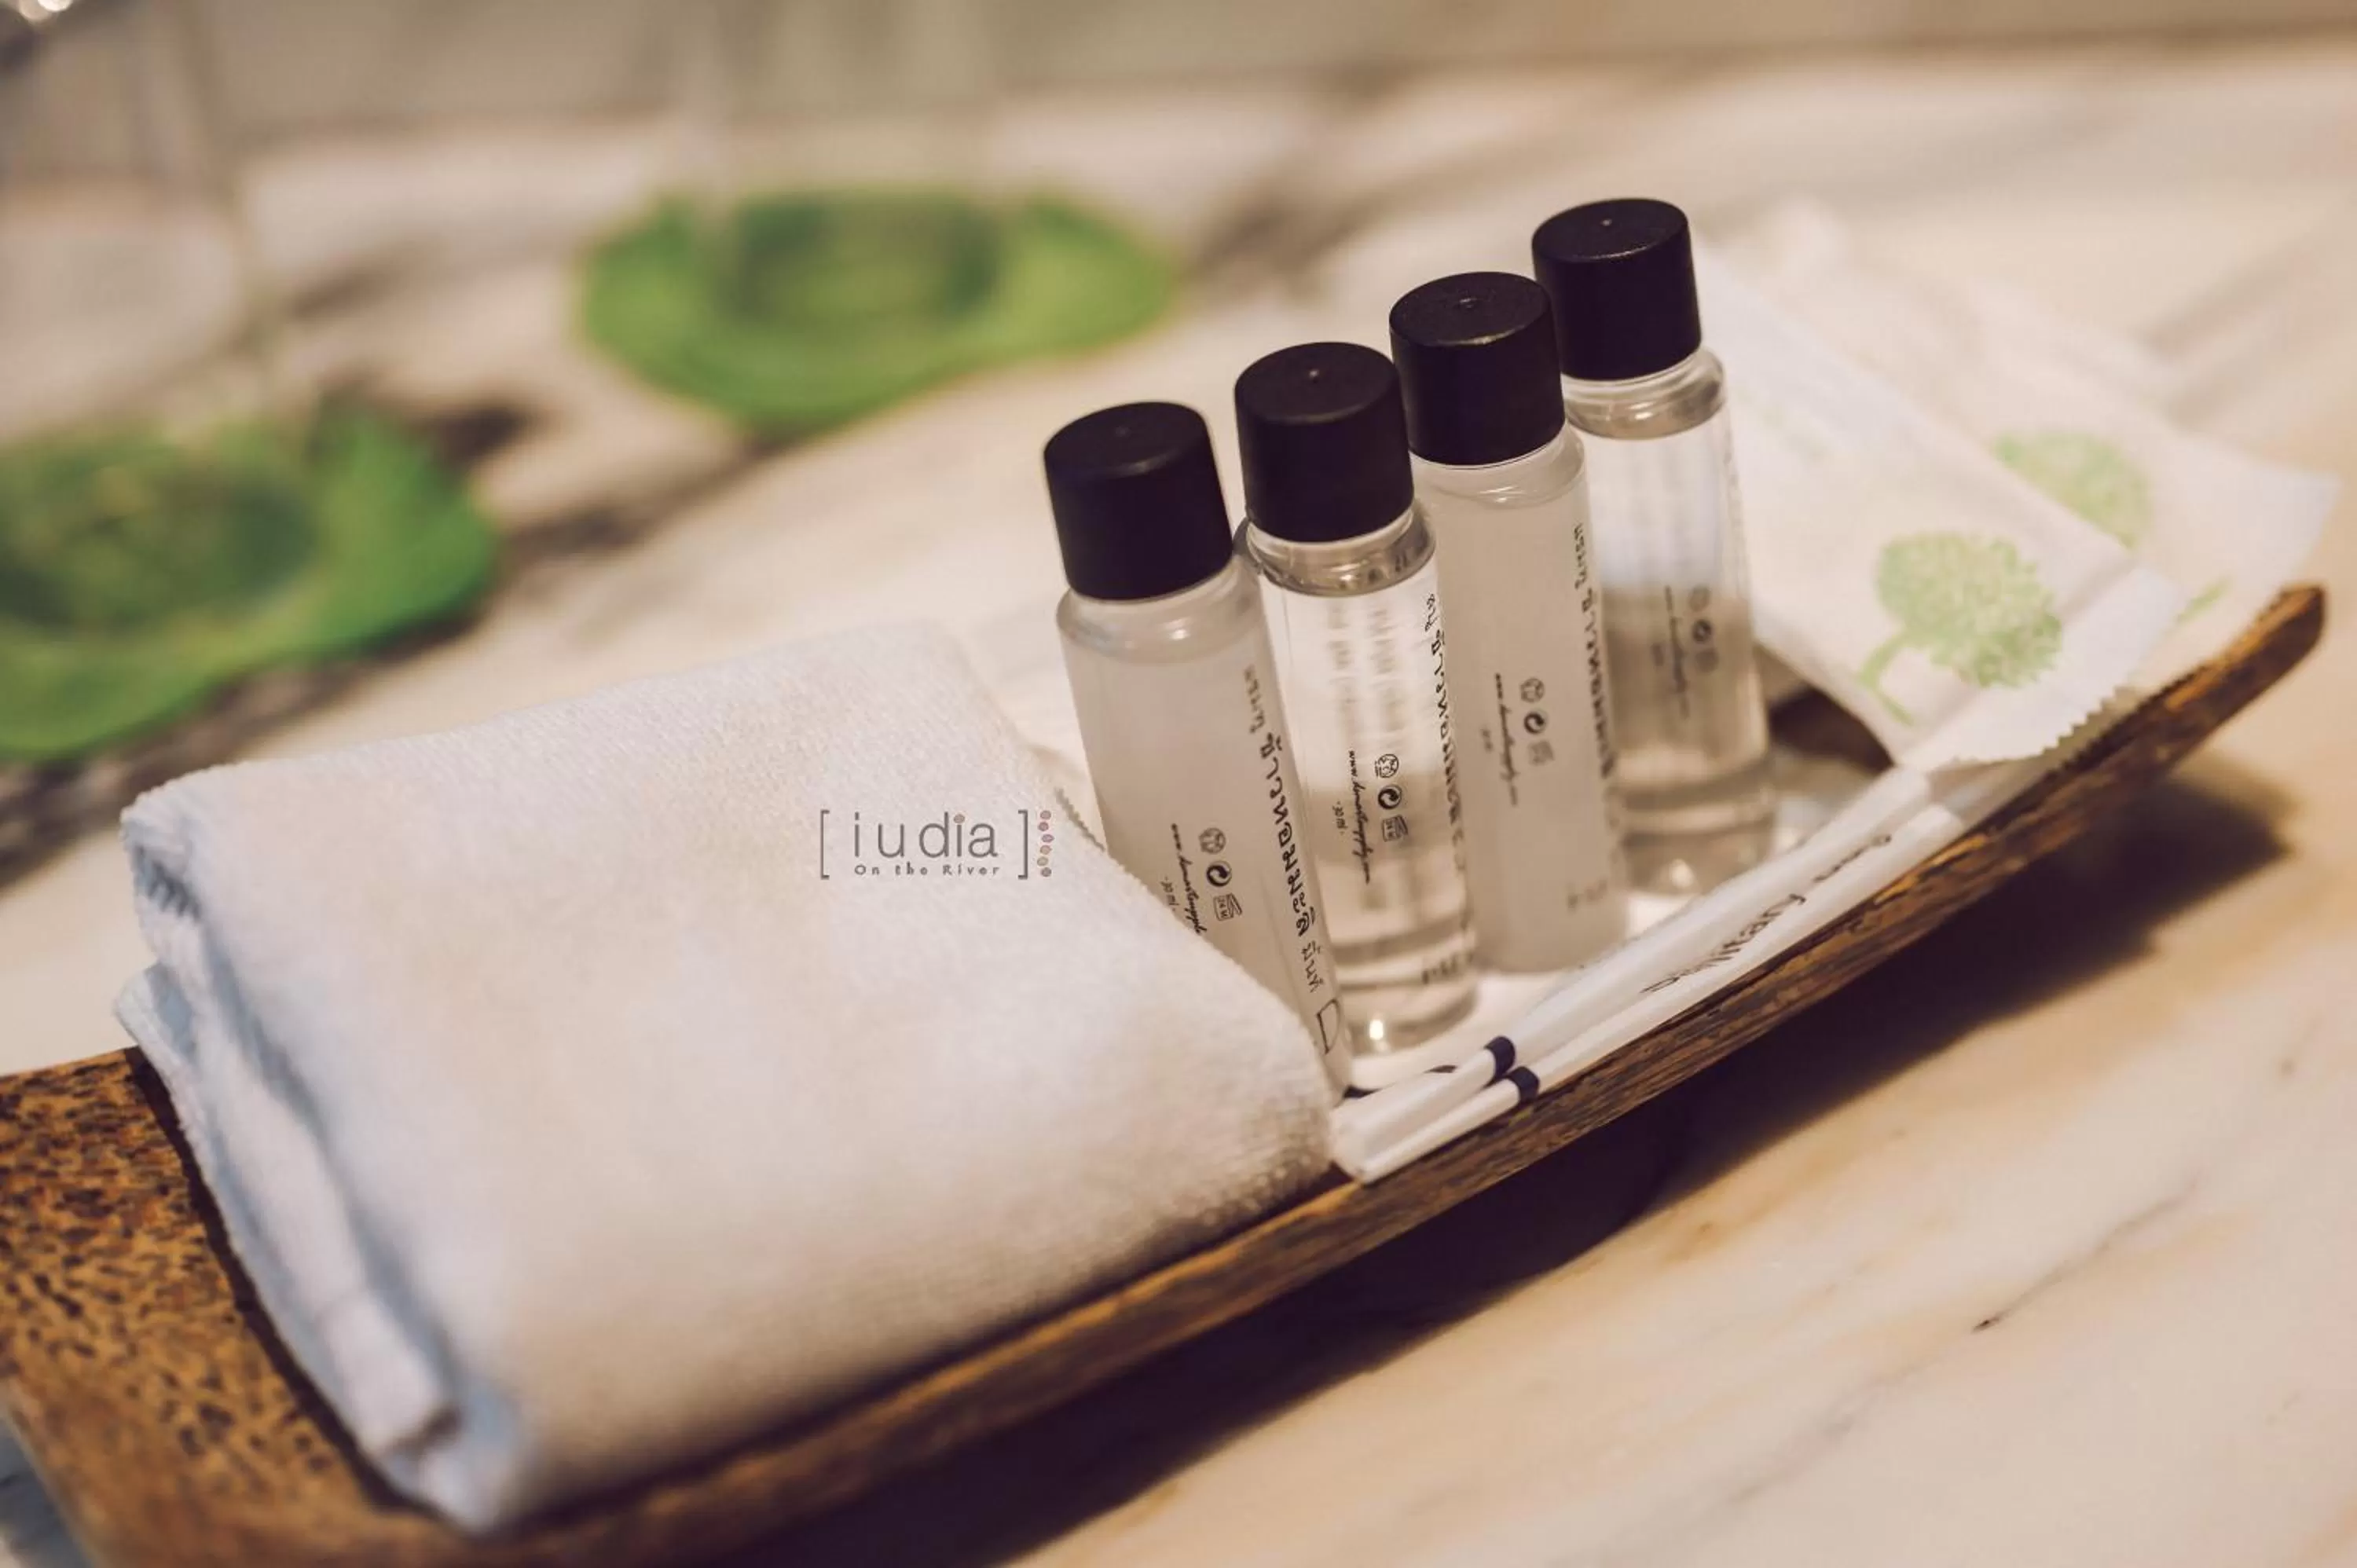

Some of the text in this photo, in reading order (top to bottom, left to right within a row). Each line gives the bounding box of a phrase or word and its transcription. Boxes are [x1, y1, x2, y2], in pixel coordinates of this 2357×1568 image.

[1260, 732, 1316, 937] ข้าวหอมมะลิ
